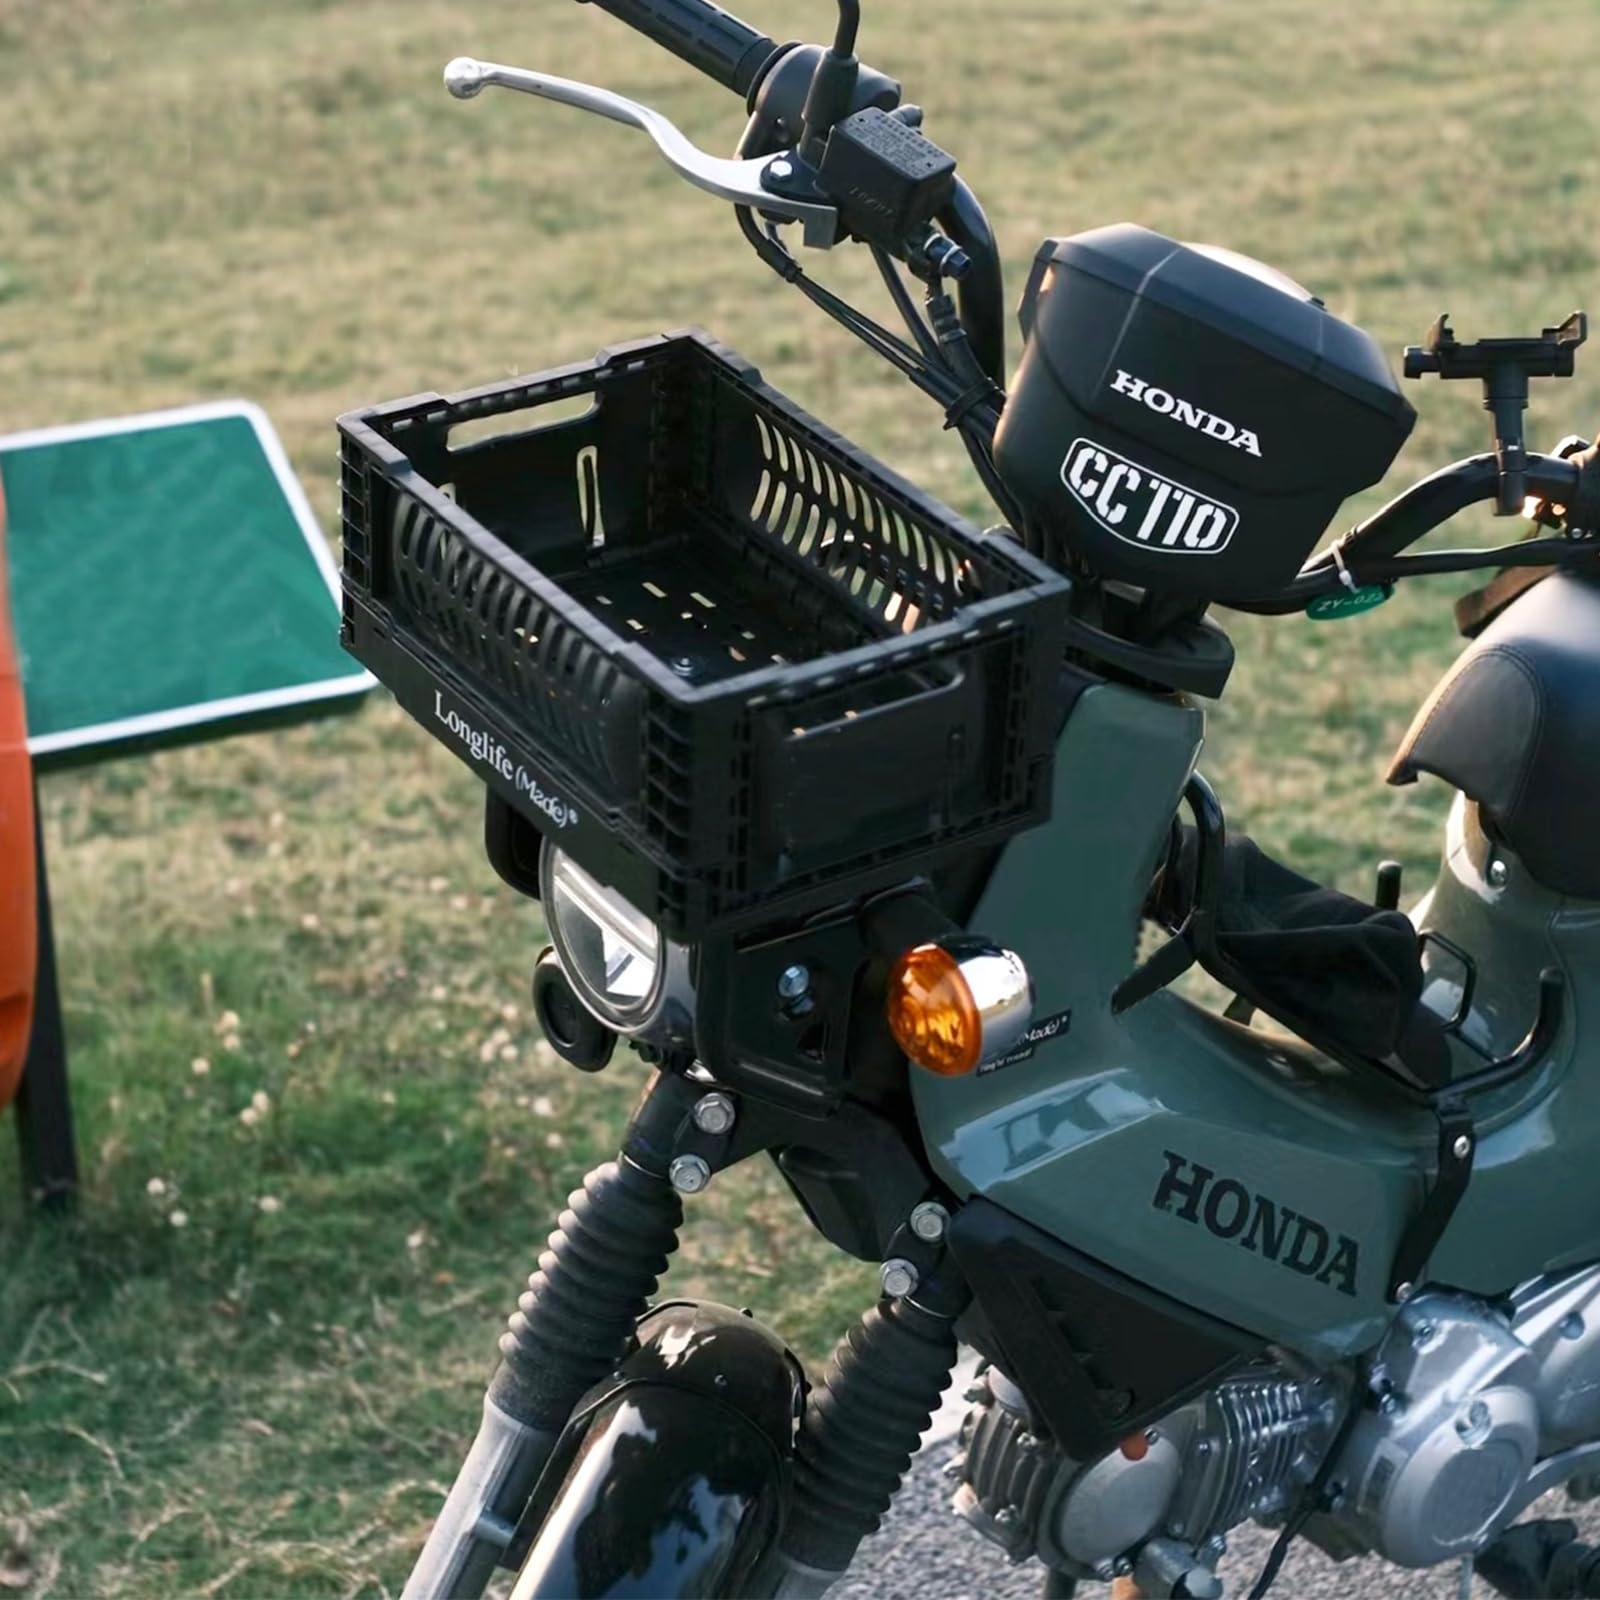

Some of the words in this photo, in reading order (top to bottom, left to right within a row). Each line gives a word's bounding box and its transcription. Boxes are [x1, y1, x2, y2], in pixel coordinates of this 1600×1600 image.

[1110, 369, 1262, 457] HONDA
[434, 689, 514, 780] Longlife
[1152, 1150, 1359, 1297] HONDA
